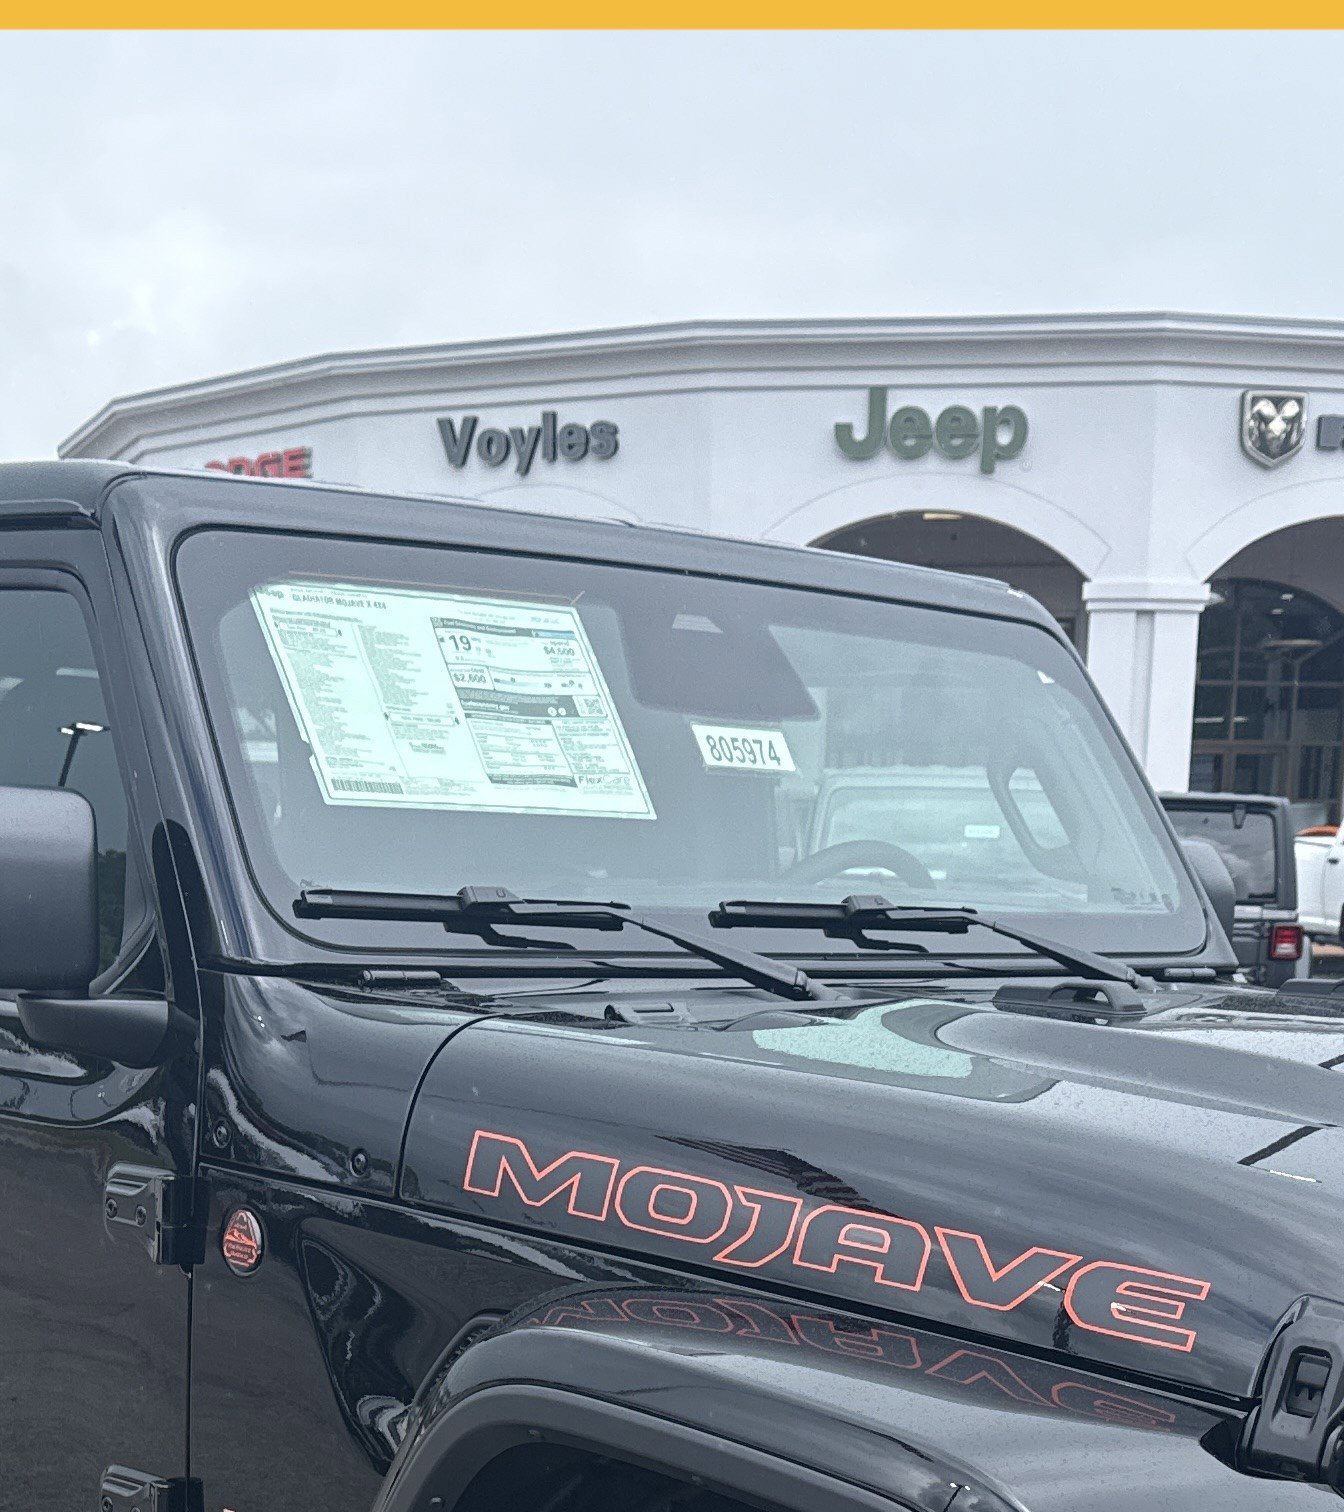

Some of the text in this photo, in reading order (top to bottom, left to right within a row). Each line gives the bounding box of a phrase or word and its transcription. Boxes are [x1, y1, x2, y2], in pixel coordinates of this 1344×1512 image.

[437, 411, 619, 476] Voyles
[834, 386, 1030, 474] Jeep
[203, 445, 313, 479] DGE
[449, 634, 472, 652] 19
[706, 734, 781, 766] 805974
[463, 1130, 1211, 1352] MOJAVE
